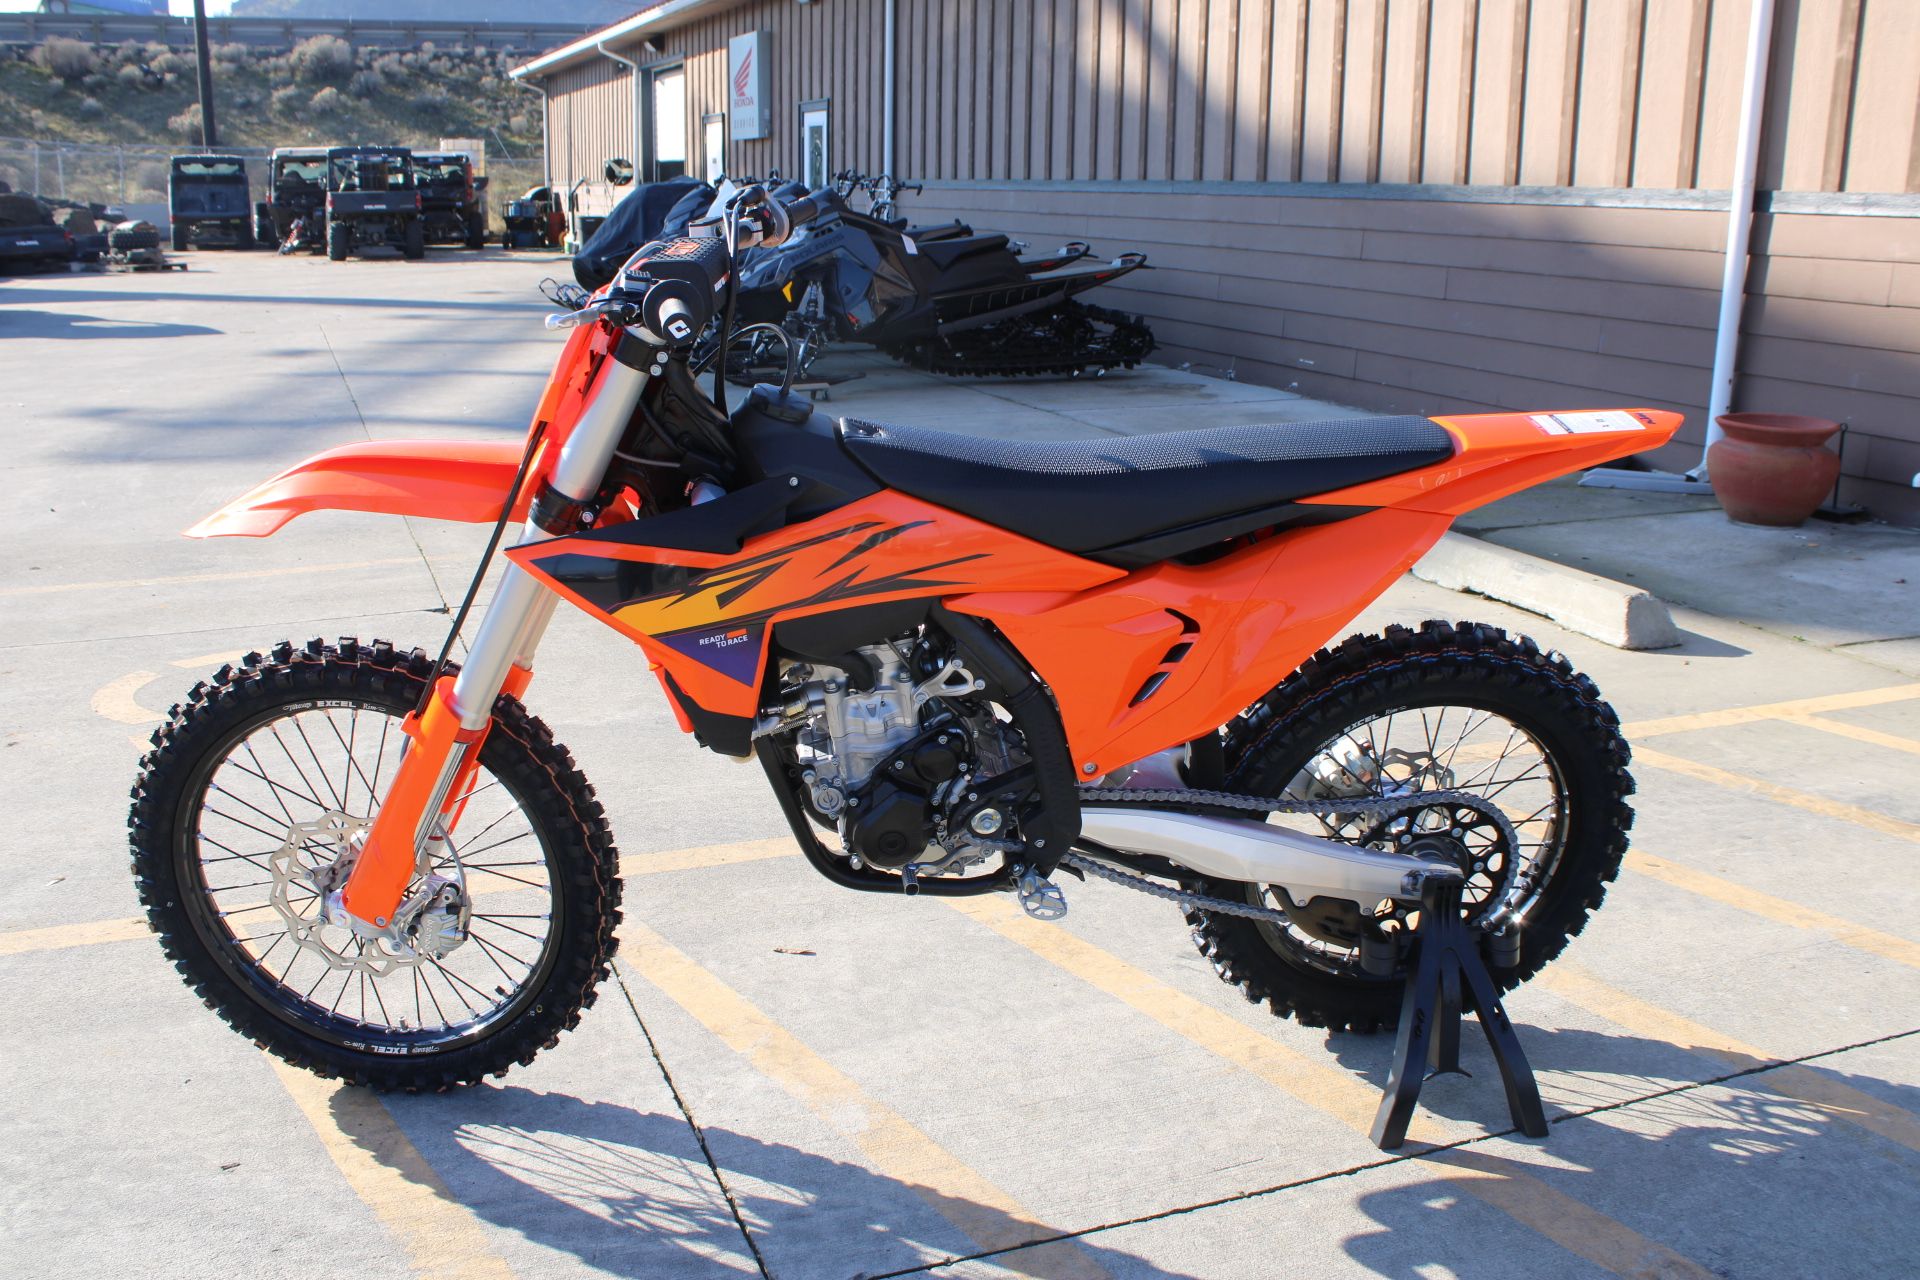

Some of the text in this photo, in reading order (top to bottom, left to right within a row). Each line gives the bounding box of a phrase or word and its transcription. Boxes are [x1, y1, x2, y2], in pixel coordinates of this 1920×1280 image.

[699, 633, 726, 646] READY
[716, 634, 748, 648] TO RACE
[315, 700, 357, 708] EXCEL
[1343, 714, 1380, 733] EXCEL
[371, 1045, 408, 1055] EXCEL
